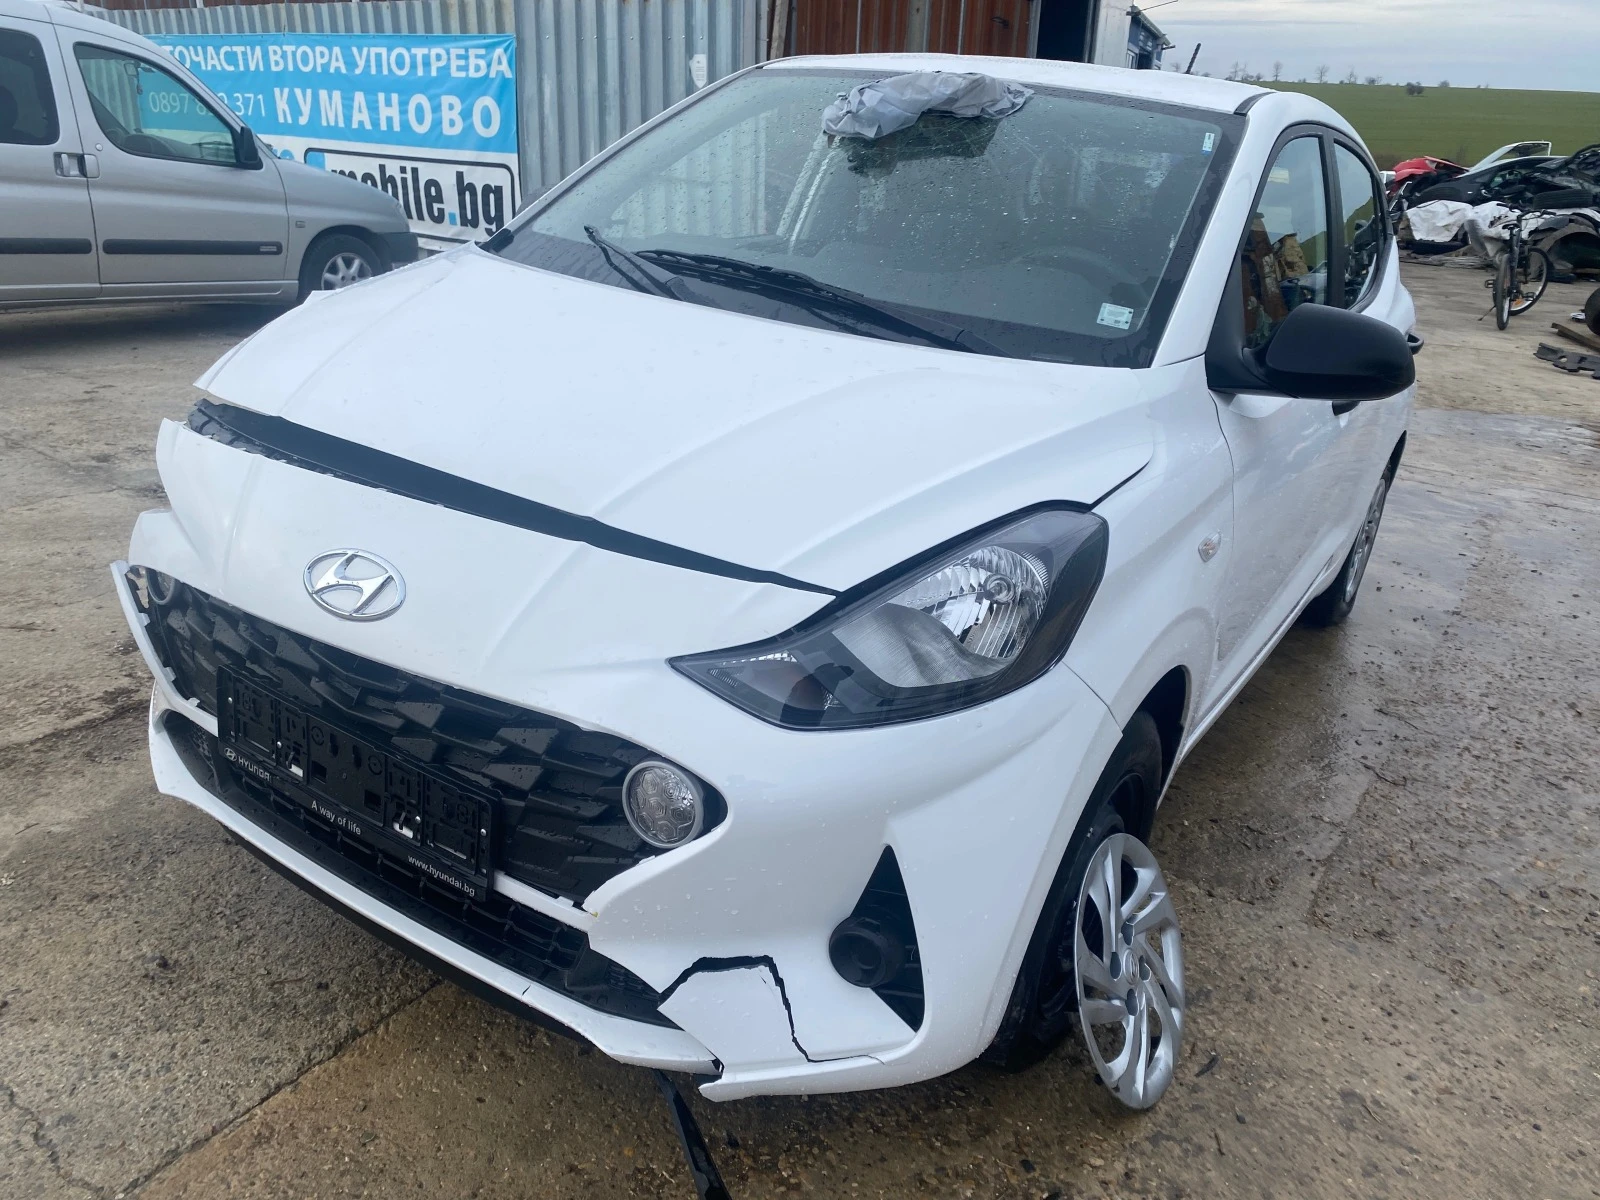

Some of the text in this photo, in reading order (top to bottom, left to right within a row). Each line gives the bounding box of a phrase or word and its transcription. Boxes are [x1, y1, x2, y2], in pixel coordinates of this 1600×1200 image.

[268, 44, 347, 74] ВТОРА
[351, 46, 513, 79] УПОТРЕБА
[148, 91, 189, 114] 0897
[233, 92, 266, 117] 371
[273, 87, 501, 138] КУМАНОВО
[331, 163, 505, 238] bile.bg
[311, 800, 361, 835] A way of life
[407, 855, 475, 897] www.hyundai.bg
